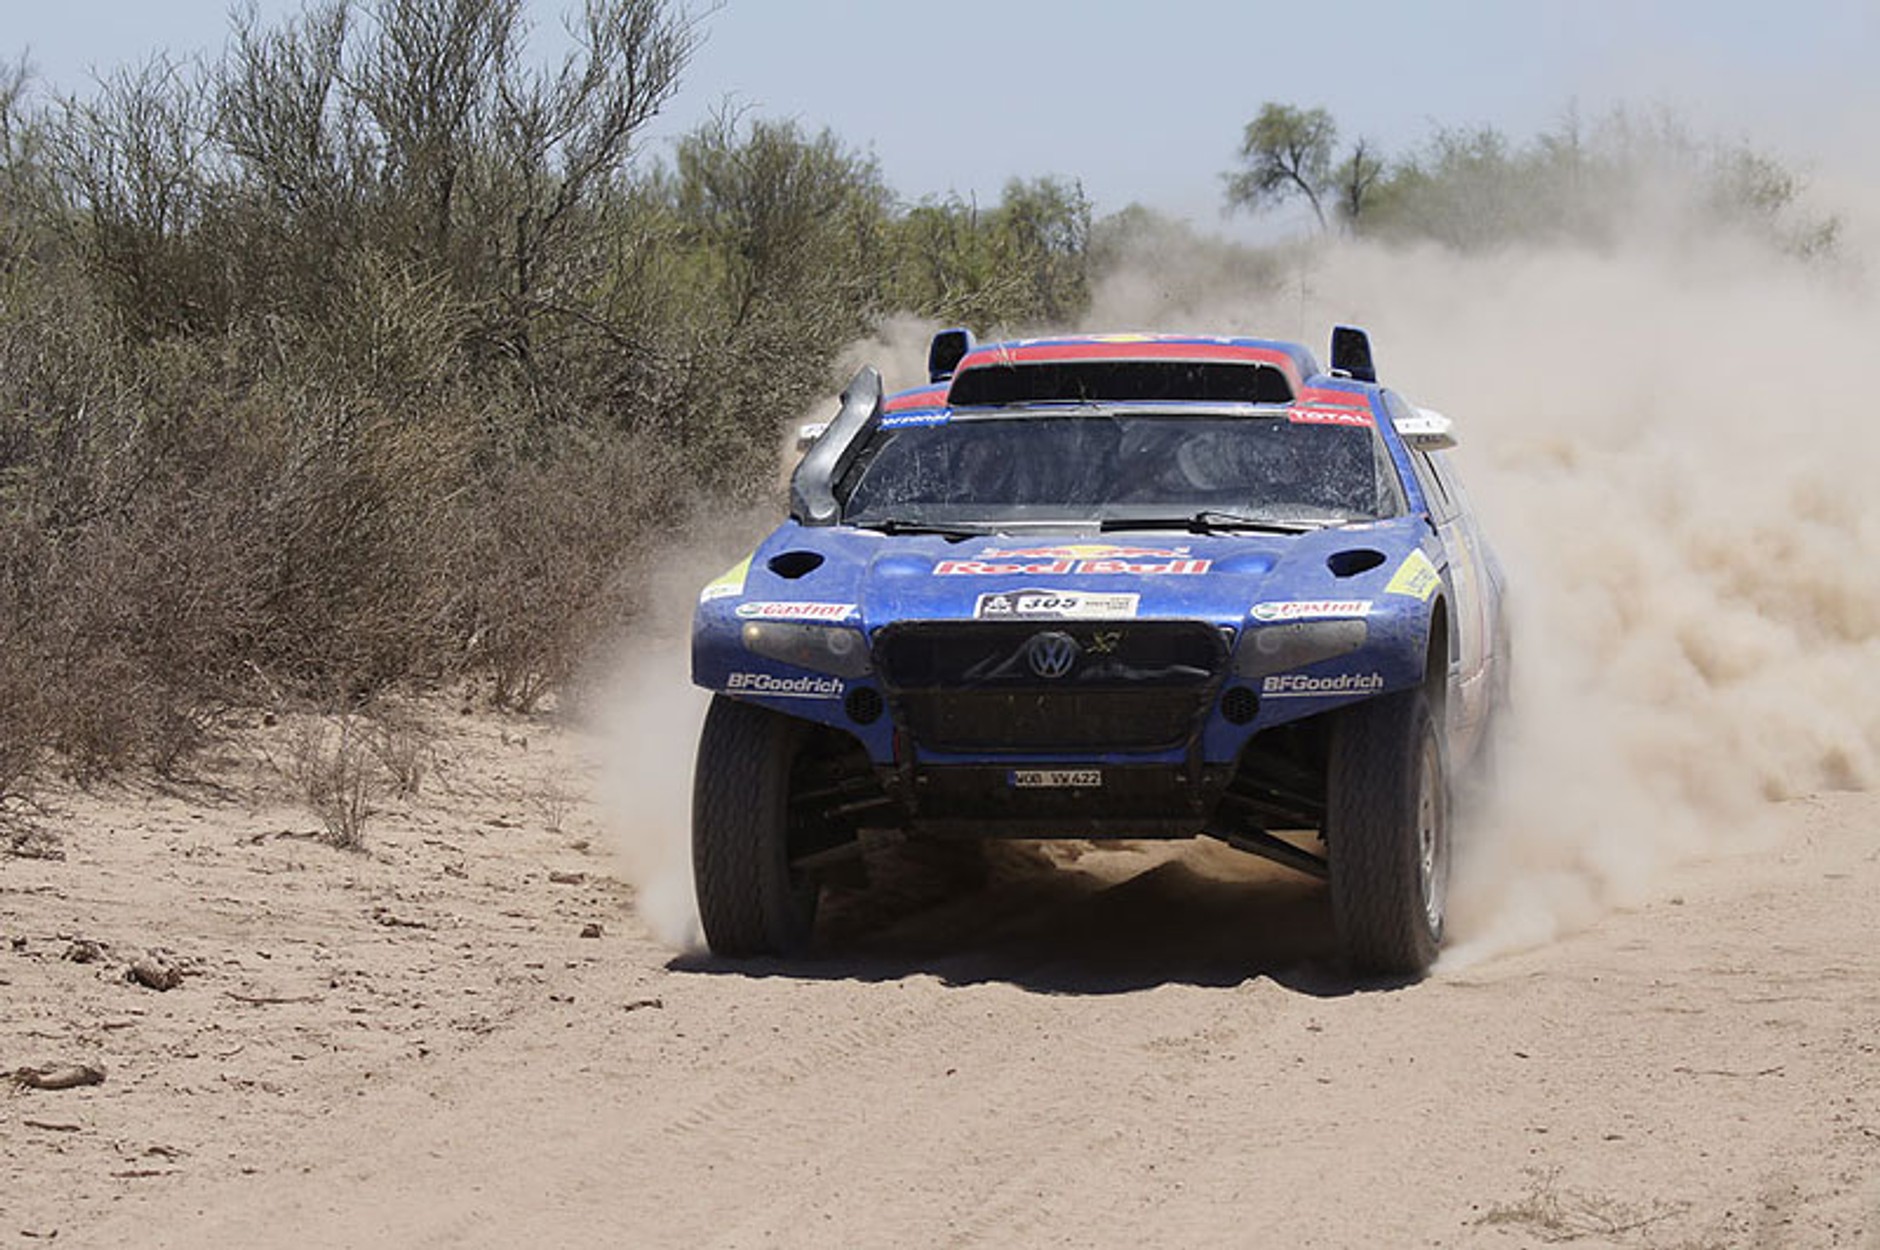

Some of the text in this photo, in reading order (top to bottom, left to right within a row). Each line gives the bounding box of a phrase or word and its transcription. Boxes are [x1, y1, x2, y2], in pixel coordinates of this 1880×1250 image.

[1293, 410, 1371, 424] TOTAL
[933, 559, 1213, 575] Red Bull
[763, 604, 845, 616] Castrol
[1024, 597, 1077, 609] 305
[1280, 602, 1363, 613] Castrol
[727, 672, 845, 693] BFGoodrich
[1262, 673, 1384, 692] BFGoodrich
